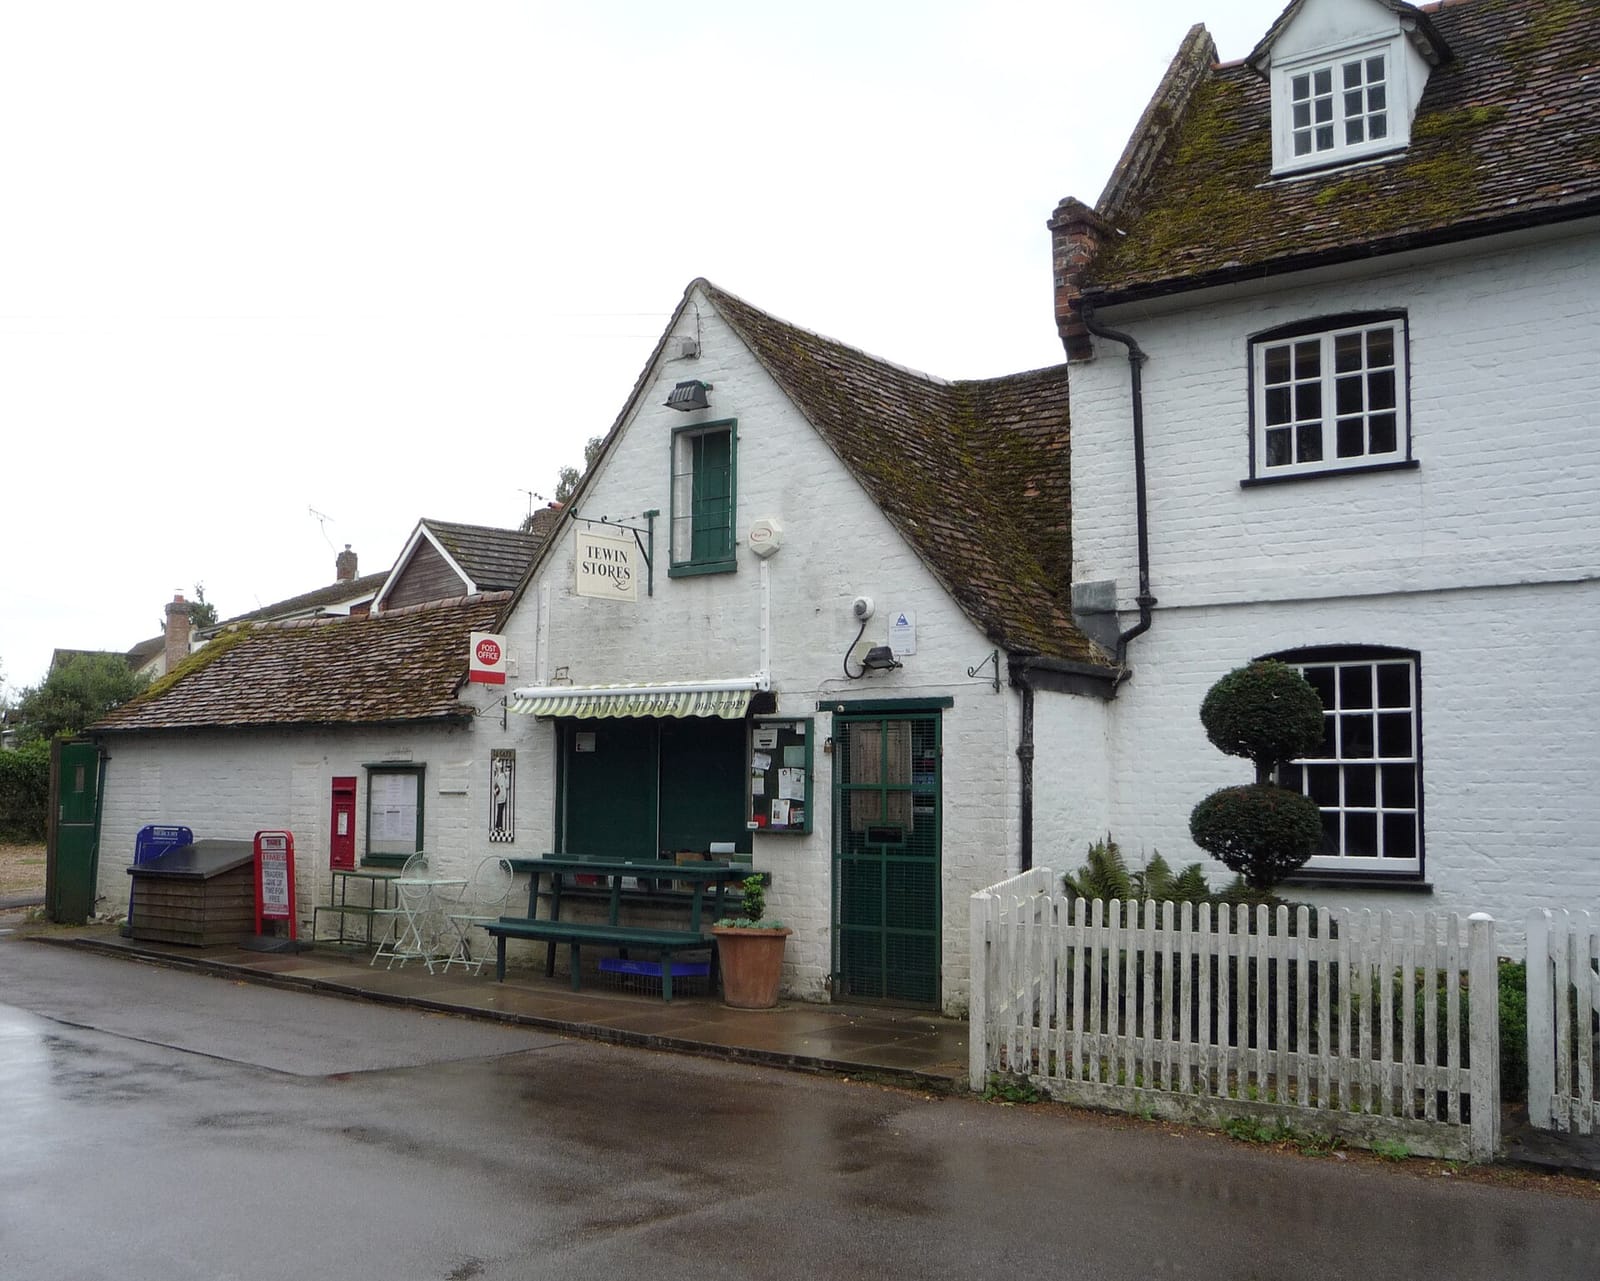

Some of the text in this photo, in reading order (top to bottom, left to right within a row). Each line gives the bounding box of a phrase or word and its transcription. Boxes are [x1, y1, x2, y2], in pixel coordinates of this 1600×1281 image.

[586, 545, 627, 563] TEWIN
[582, 561, 631, 586] STORES
[481, 644, 497, 652] POST
[477, 651, 499, 660] OFFICE
[575, 701, 624, 714] TEWIN
[624, 700, 679, 713] STORES
